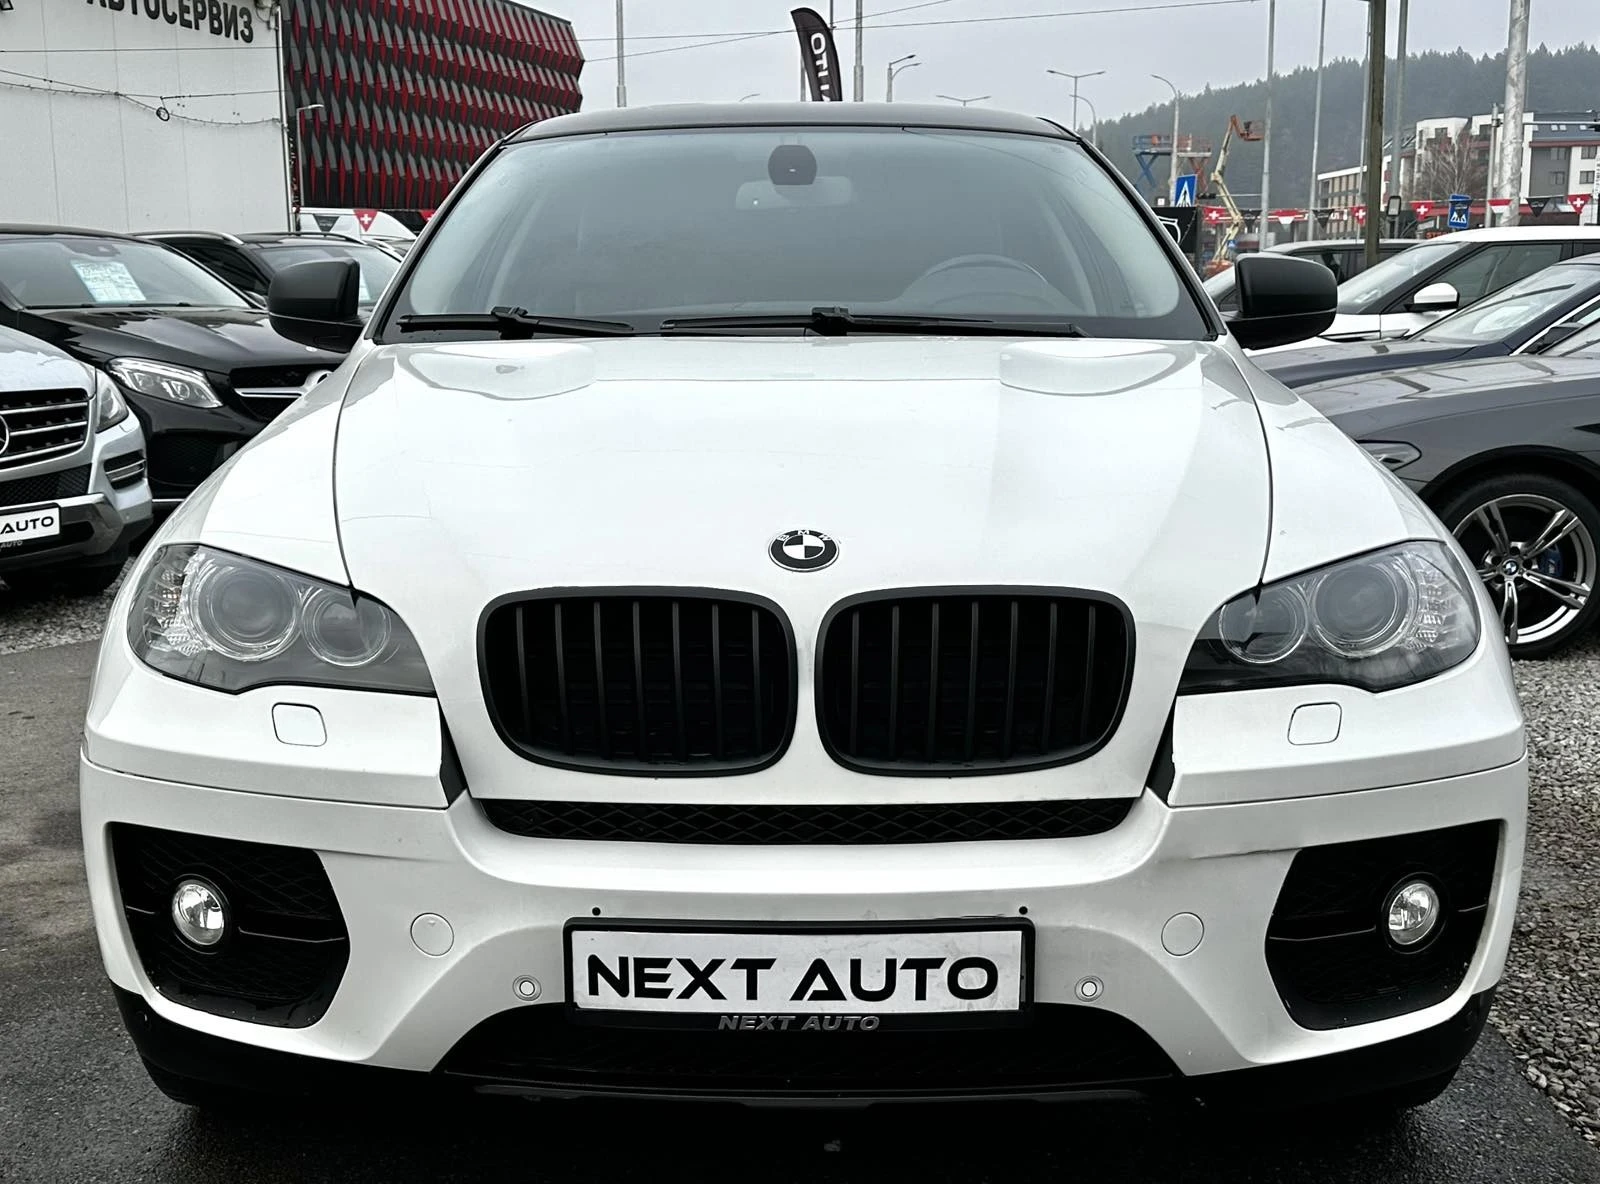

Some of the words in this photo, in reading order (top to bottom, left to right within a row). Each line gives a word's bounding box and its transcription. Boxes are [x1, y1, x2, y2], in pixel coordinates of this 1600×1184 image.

[0, 516, 54, 535] AUTO
[587, 953, 777, 1001] NEXT
[789, 956, 999, 1002] AUTO
[717, 1015, 796, 1031] NEXT
[801, 1015, 880, 1031] AUTO
